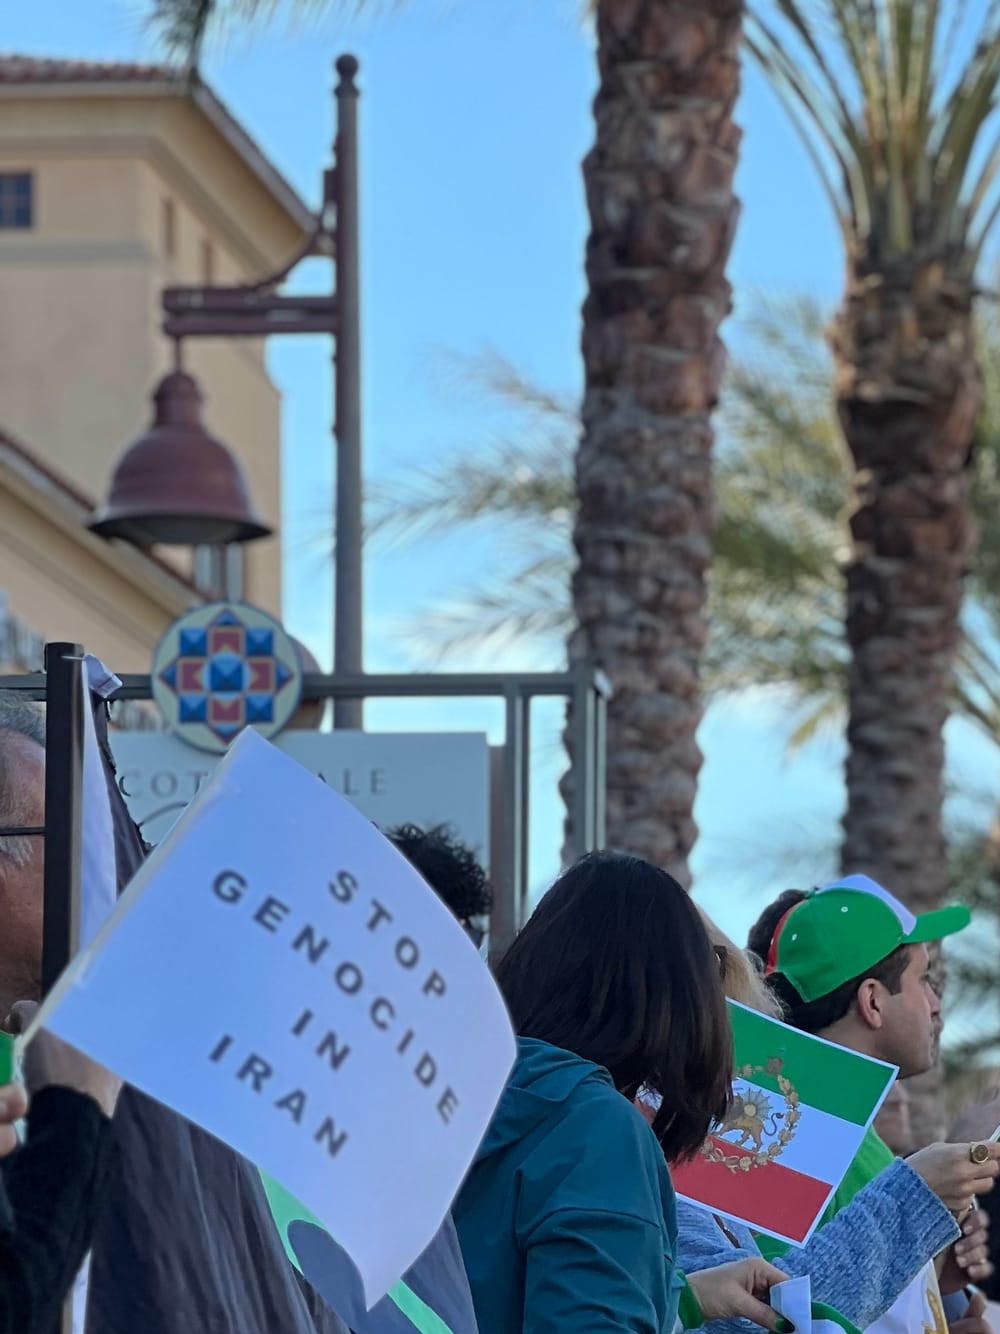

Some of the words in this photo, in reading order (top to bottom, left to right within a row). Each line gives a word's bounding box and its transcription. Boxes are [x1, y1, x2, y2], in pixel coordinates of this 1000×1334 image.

[211, 869, 459, 1124] GENOCIDE
[328, 869, 447, 998] STOP
[208, 1033, 348, 1158] IRAN
[290, 1008, 351, 1072] IN
